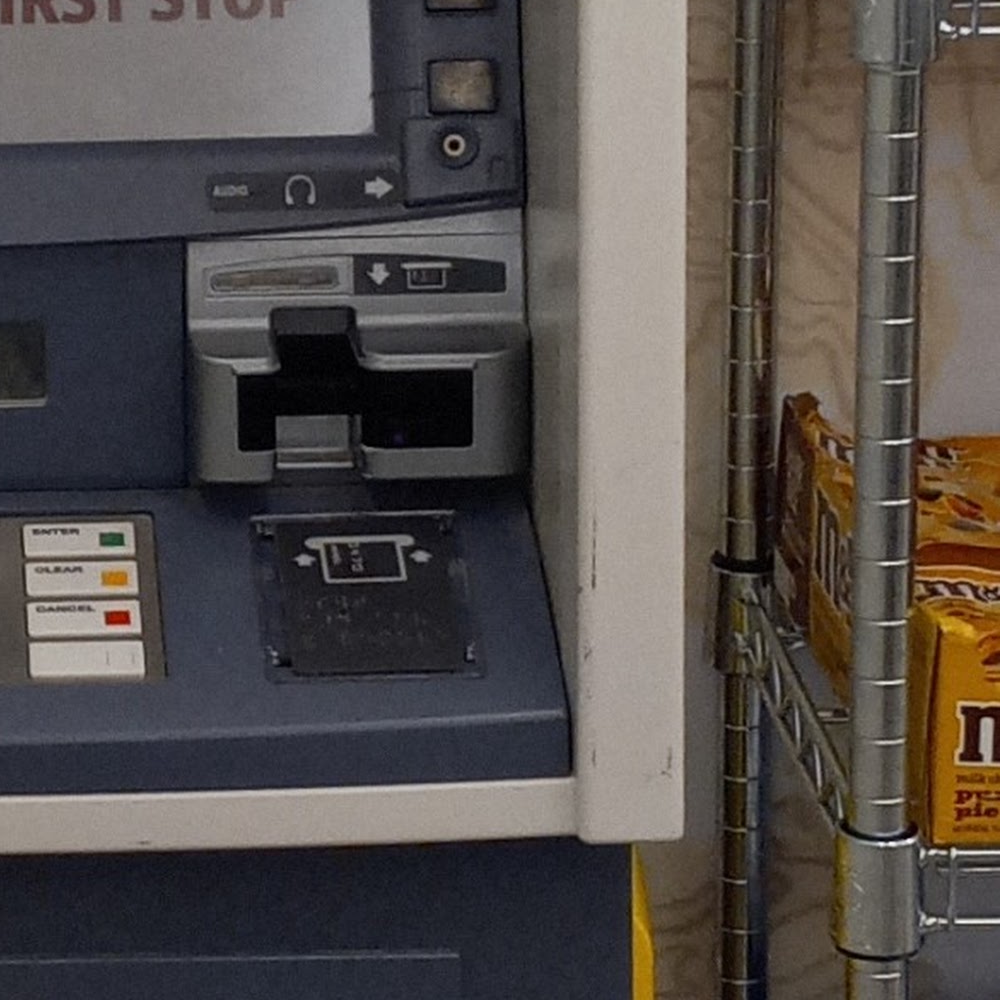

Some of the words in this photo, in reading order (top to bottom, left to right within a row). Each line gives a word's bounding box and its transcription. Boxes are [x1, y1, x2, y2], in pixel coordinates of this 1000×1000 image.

[32, 528, 79, 536] ENTER
[34, 566, 83, 574] CLEAR
[36, 605, 95, 613] CANCEL
